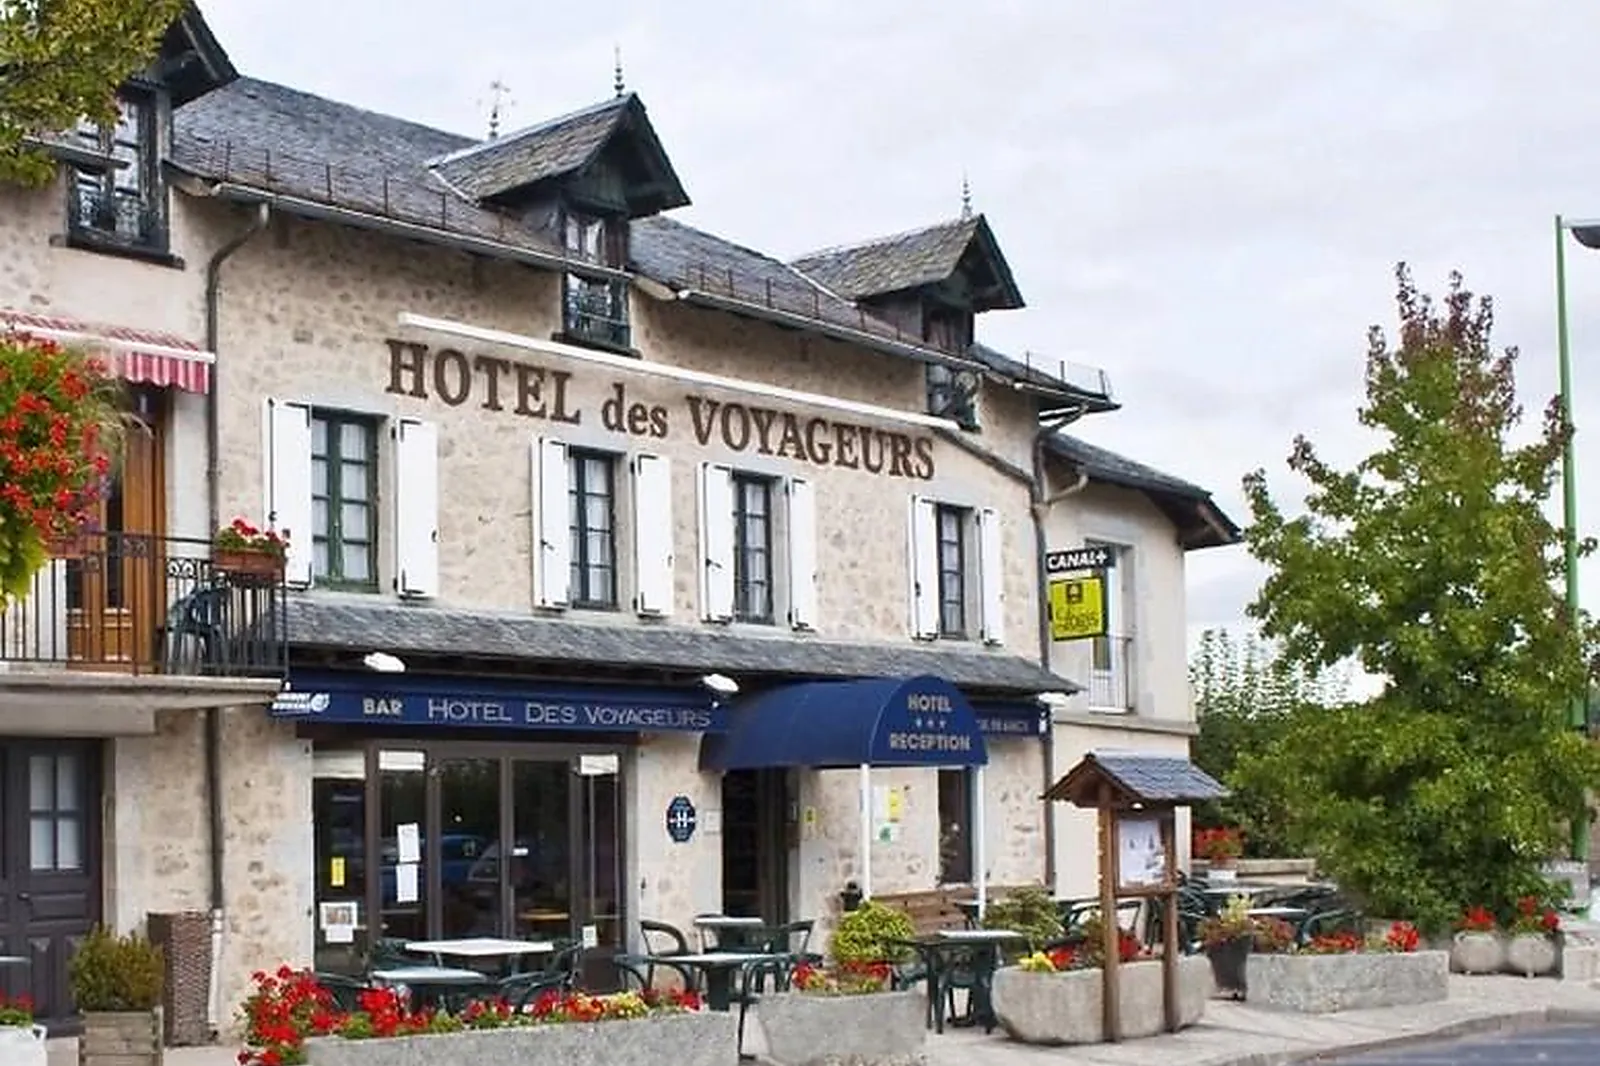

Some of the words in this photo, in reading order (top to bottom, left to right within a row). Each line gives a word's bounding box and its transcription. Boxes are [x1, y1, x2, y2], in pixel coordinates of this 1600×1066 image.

[384, 338, 581, 426] HOTEL
[601, 382, 669, 439] des
[686, 395, 936, 481] VOYAGEURS
[1048, 550, 1107, 570] CANAL+
[363, 698, 403, 715] BAR
[428, 698, 512, 721] HOTEL
[525, 702, 578, 724] DES
[584, 705, 711, 728] VOYAGEURS
[907, 693, 953, 713] HOTEL
[890, 733, 970, 750] RECEPTION
